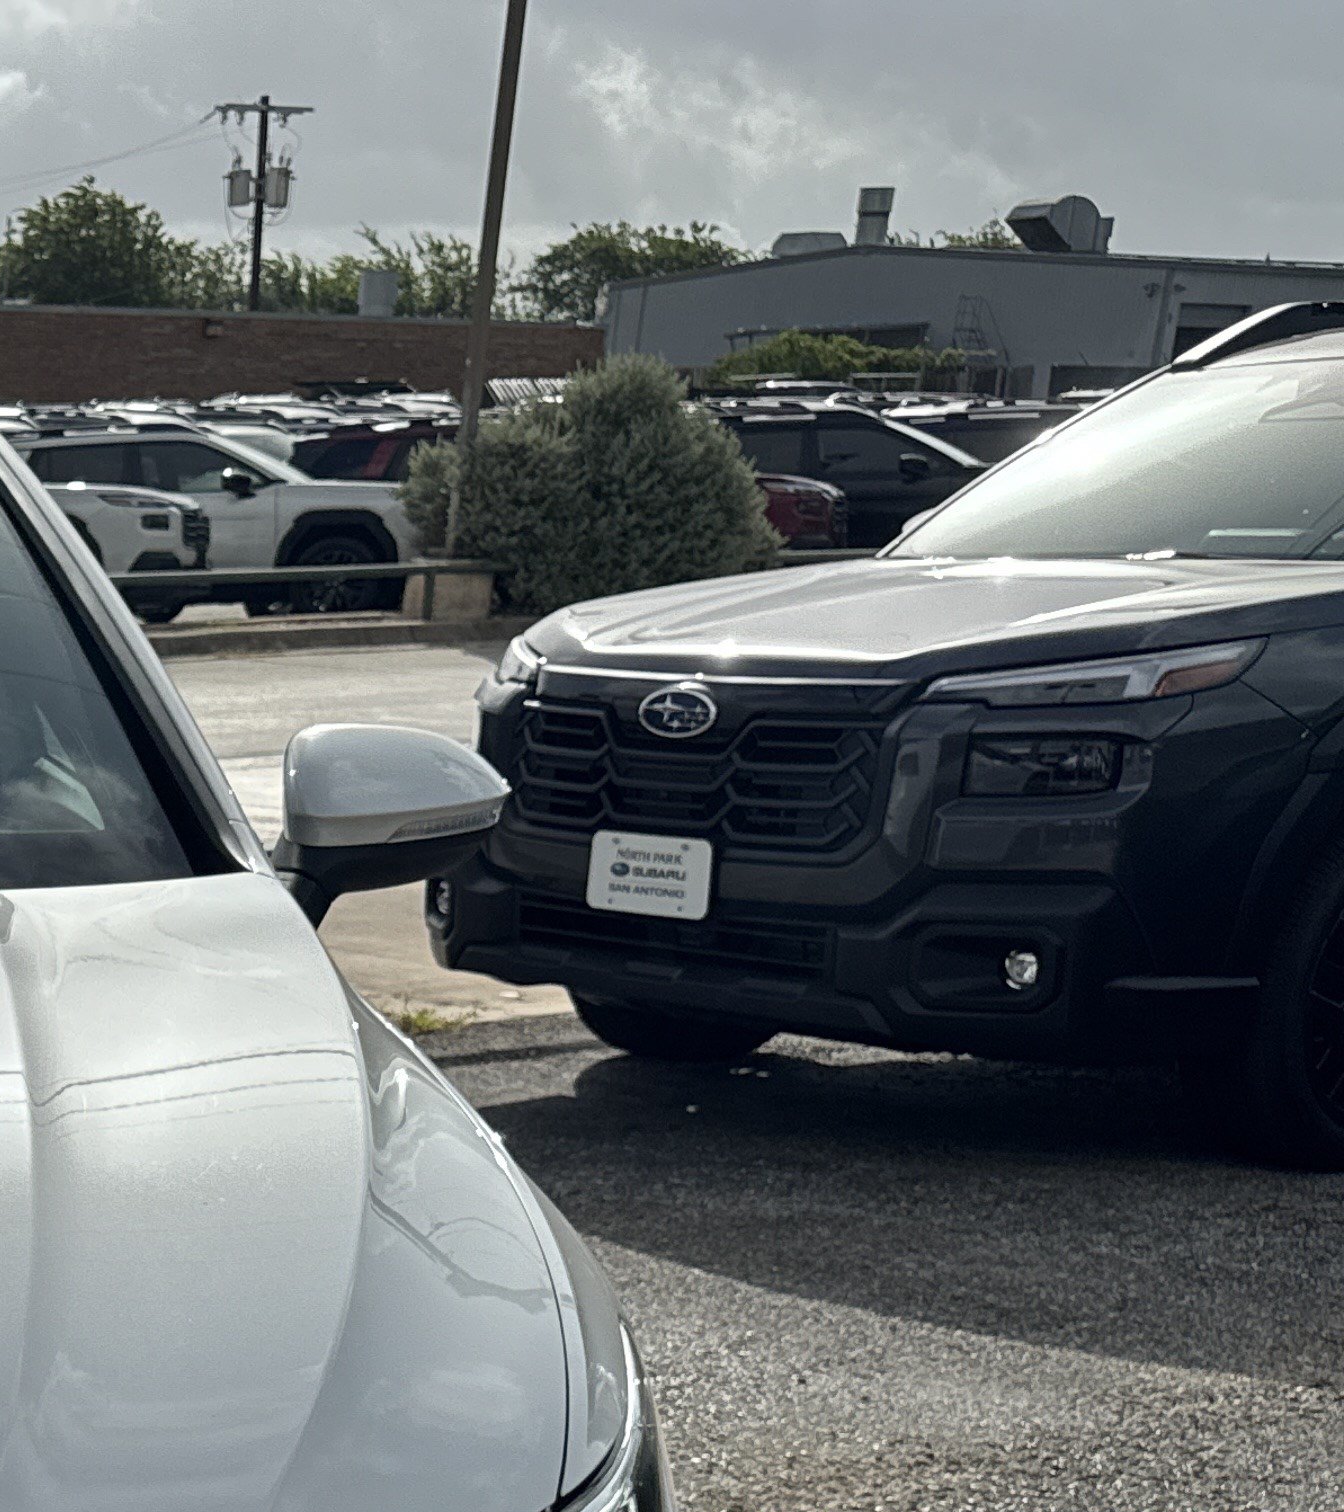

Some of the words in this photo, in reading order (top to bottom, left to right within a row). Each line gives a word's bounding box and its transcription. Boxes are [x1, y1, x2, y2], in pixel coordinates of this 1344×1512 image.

[617, 847, 651, 861] NORTH
[653, 852, 683, 865] PARK
[632, 865, 687, 881] SUBARU
[608, 882, 631, 893] SAN
[633, 885, 686, 899] ANTONIO
